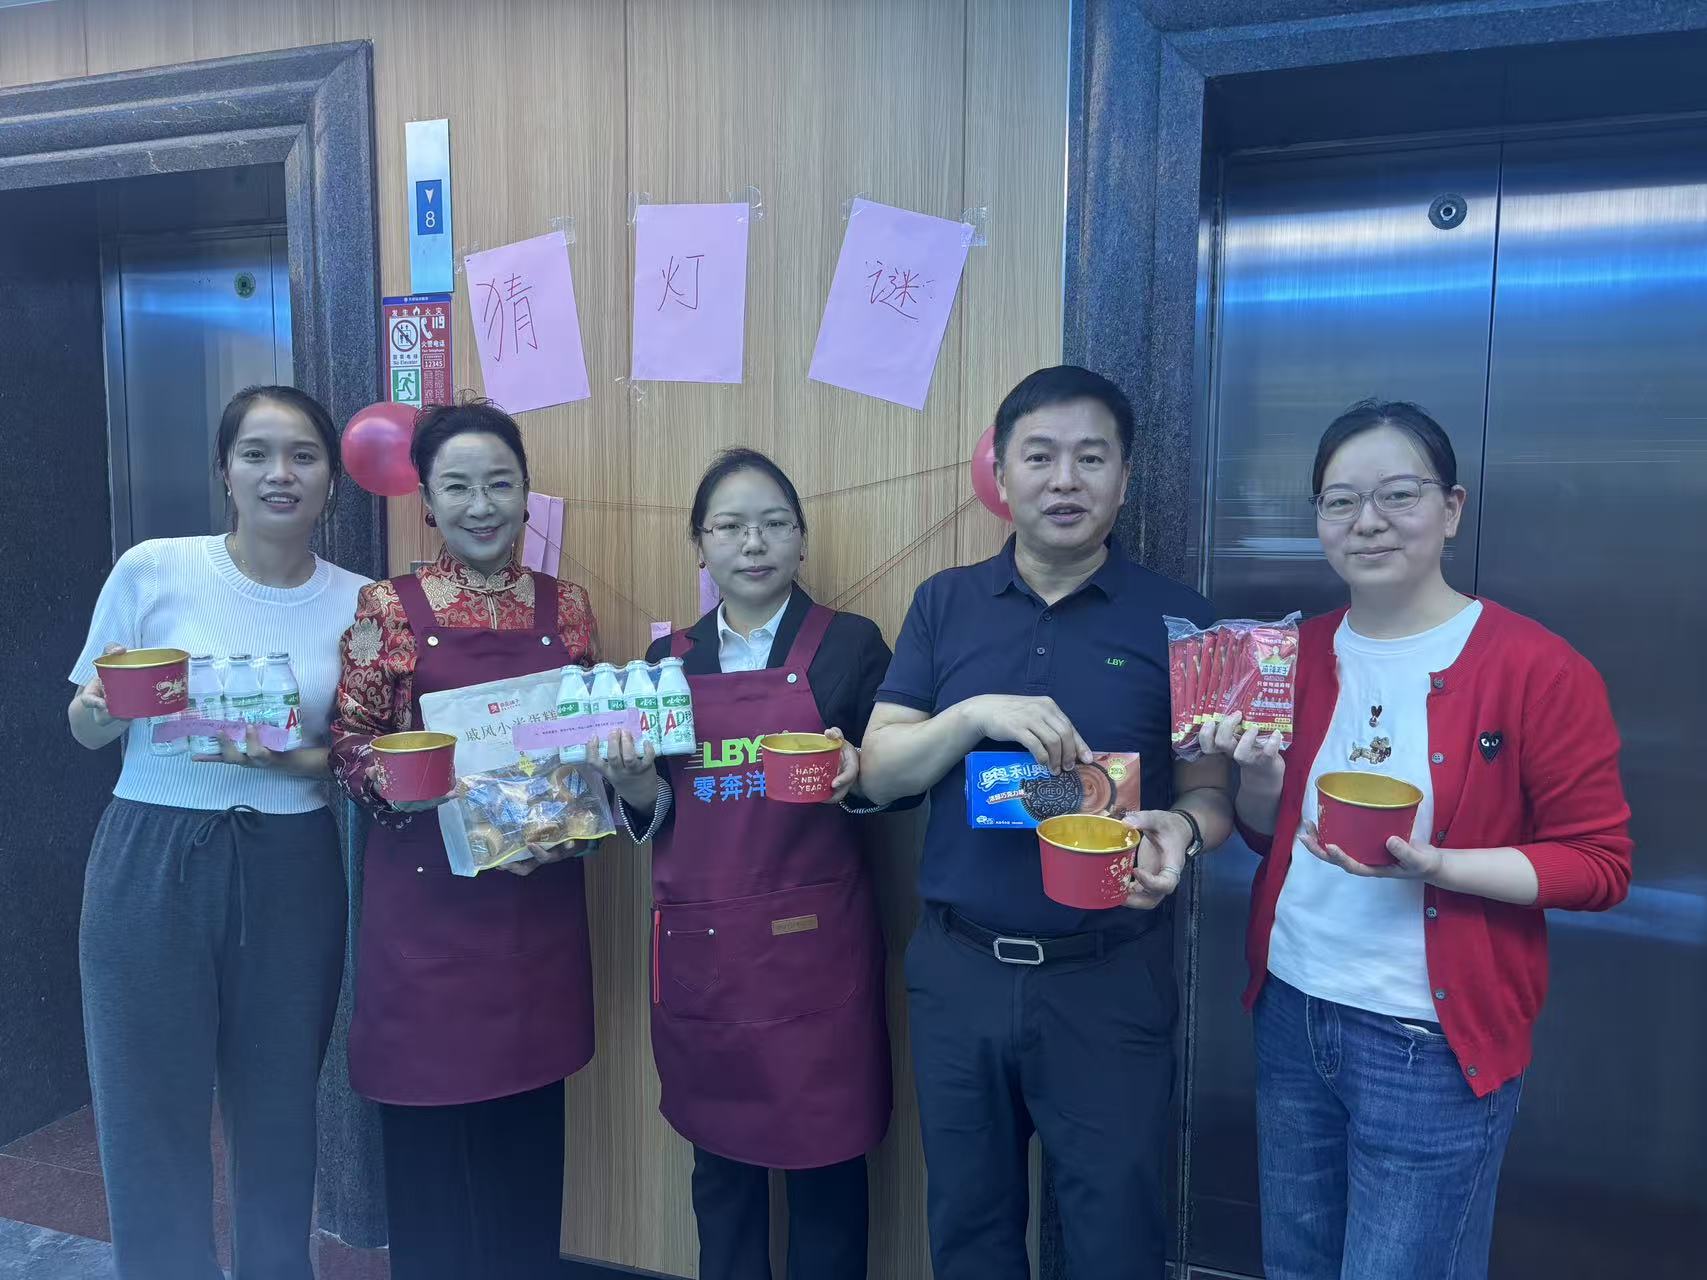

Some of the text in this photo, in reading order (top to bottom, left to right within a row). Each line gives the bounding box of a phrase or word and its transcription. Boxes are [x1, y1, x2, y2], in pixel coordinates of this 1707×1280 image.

[425, 210, 435, 228] 8
[476, 254, 920, 362] 猜 灯 谜
[432, 316, 445, 329] 119
[425, 360, 443, 368] 12345
[1107, 658, 1124, 666] LBY
[703, 734, 765, 768] LBY
[796, 766, 826, 776] HAPPY
[980, 764, 1050, 789] 奥利奥
[694, 769, 766, 803] 零奔洋
[799, 784, 822, 792] YEAR
[1040, 787, 1062, 796] OREO
